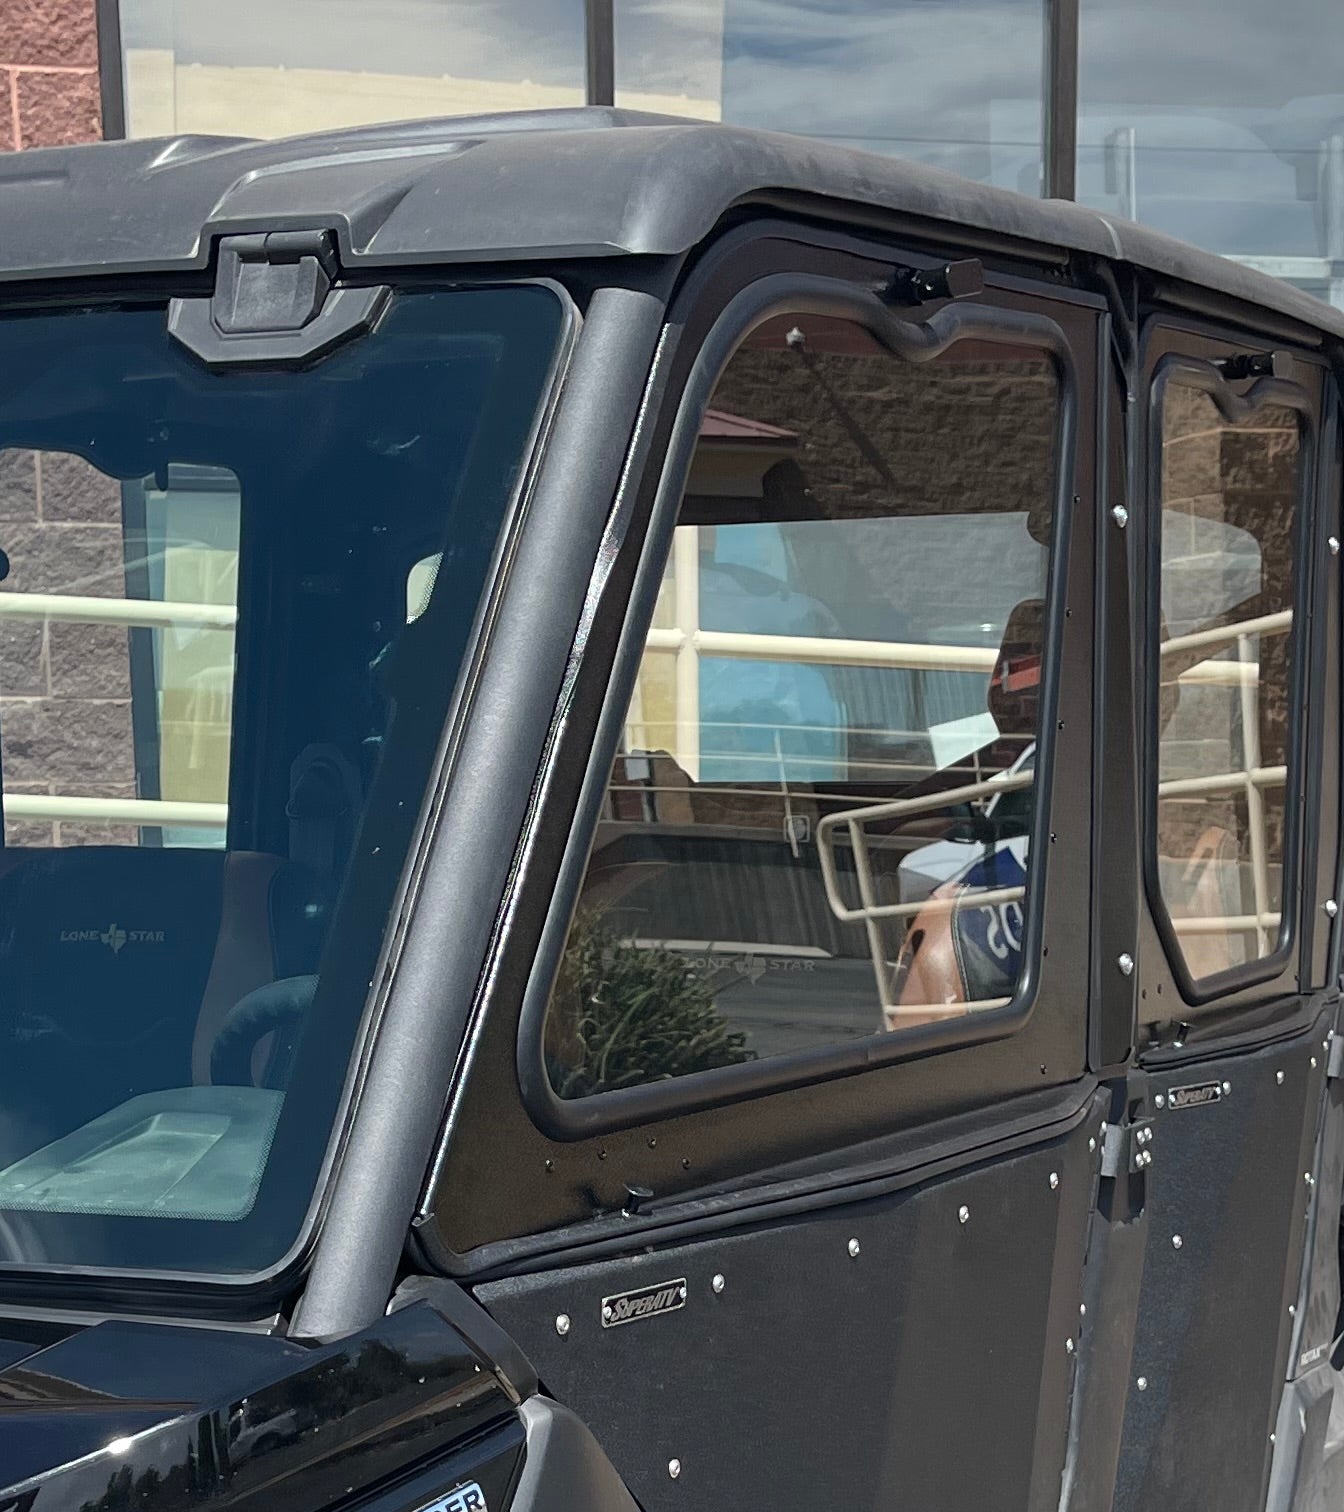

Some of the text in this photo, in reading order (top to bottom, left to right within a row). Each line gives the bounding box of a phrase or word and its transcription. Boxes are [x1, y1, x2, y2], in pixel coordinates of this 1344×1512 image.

[60, 930, 166, 942] LONE STAR
[769, 959, 817, 972] STAR
